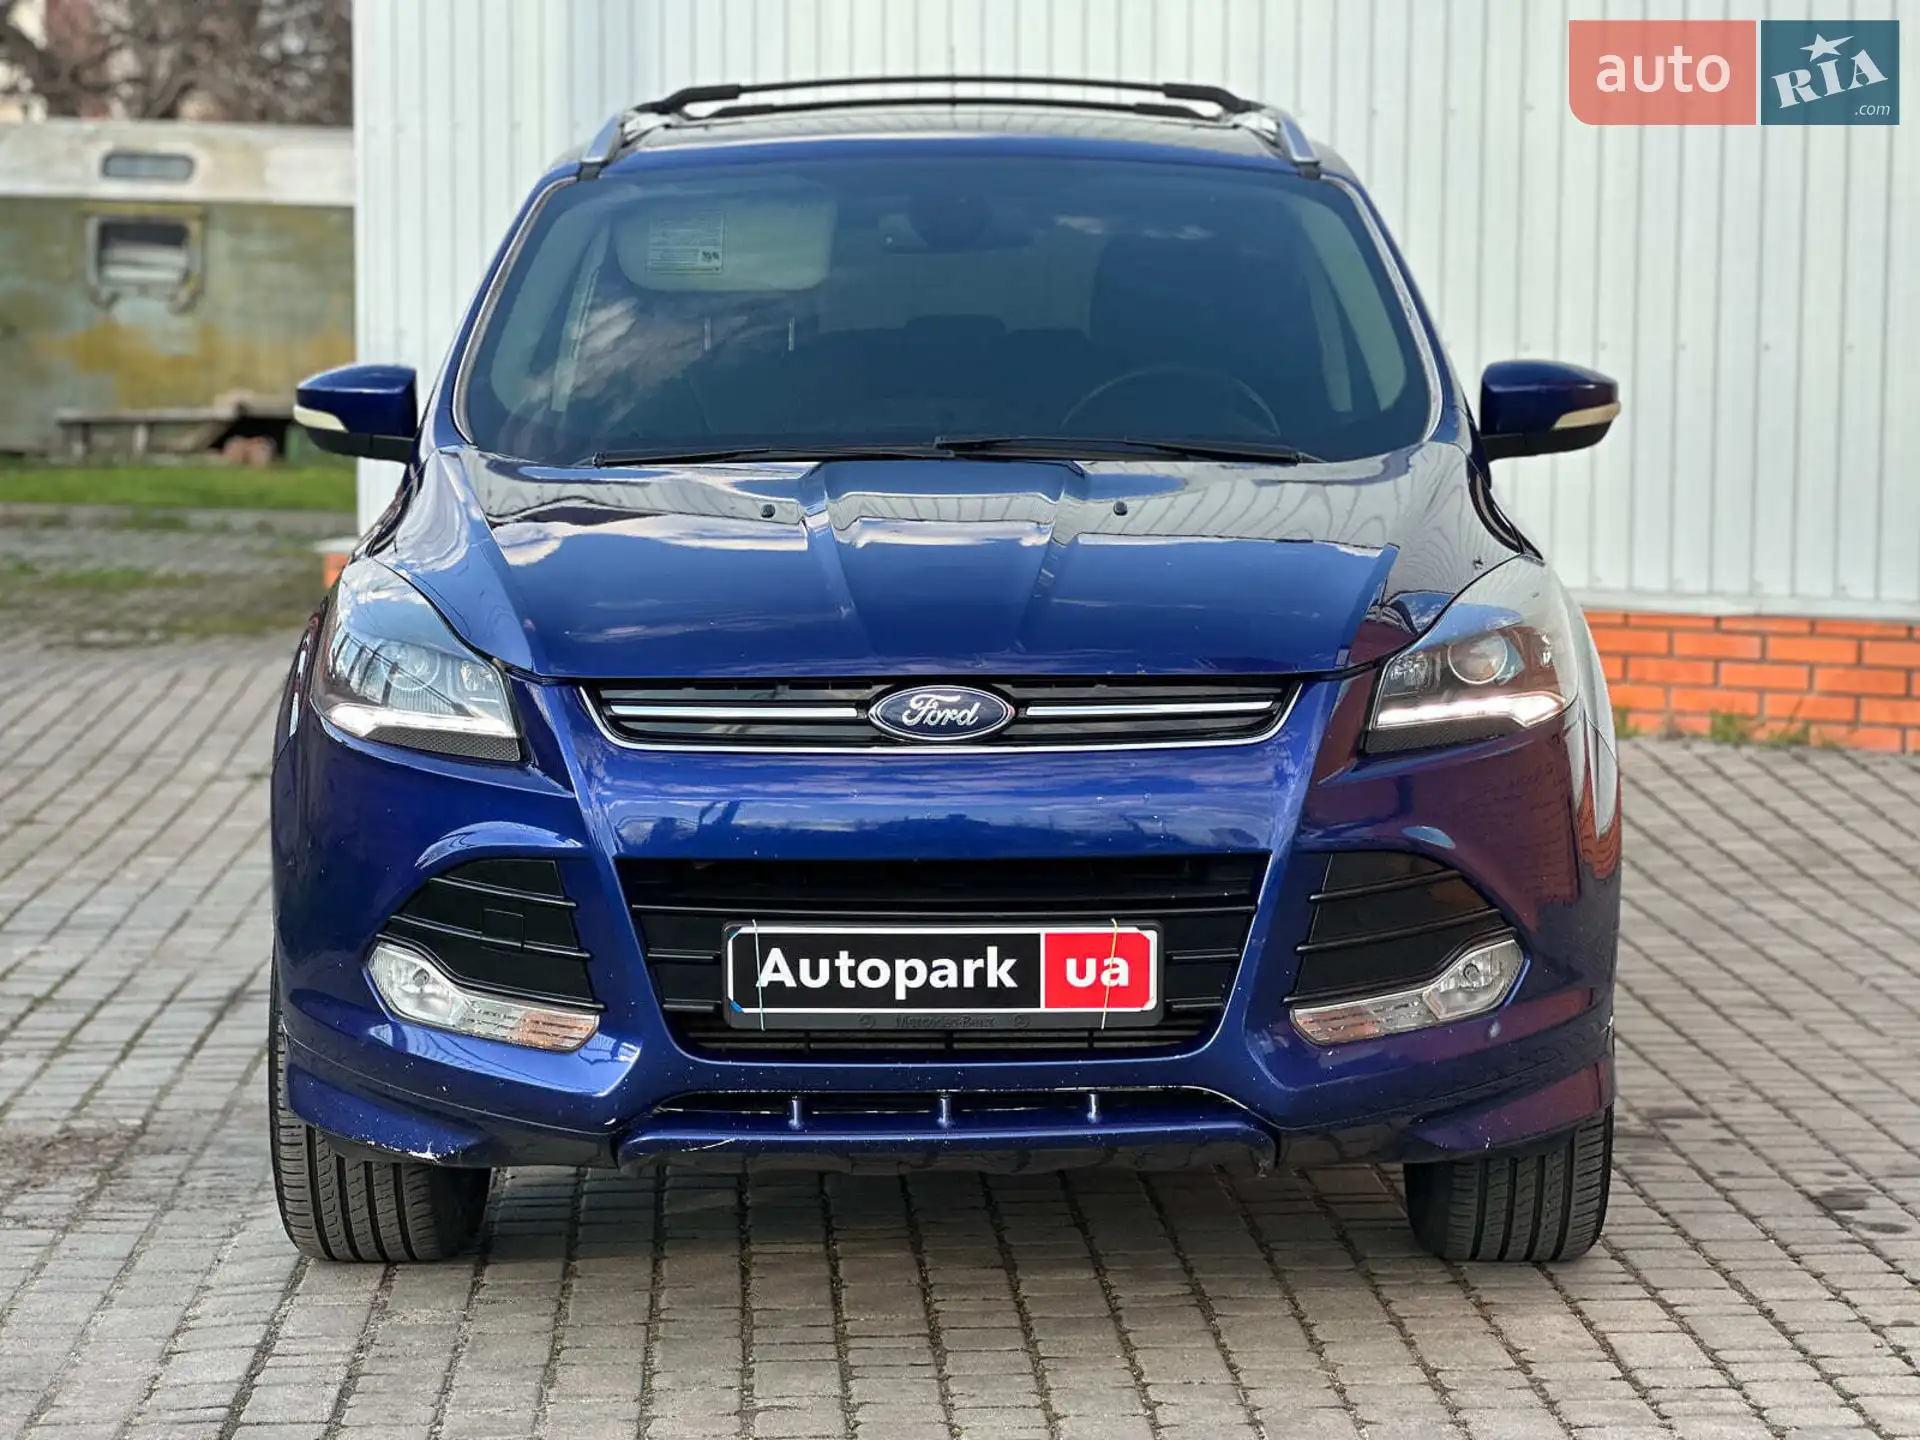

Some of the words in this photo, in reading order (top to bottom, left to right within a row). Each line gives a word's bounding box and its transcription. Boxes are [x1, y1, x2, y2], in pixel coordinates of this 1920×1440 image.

[902, 694, 981, 726] Ford
[756, 946, 1018, 1000] Autopark
[1065, 957, 1130, 988] ua
